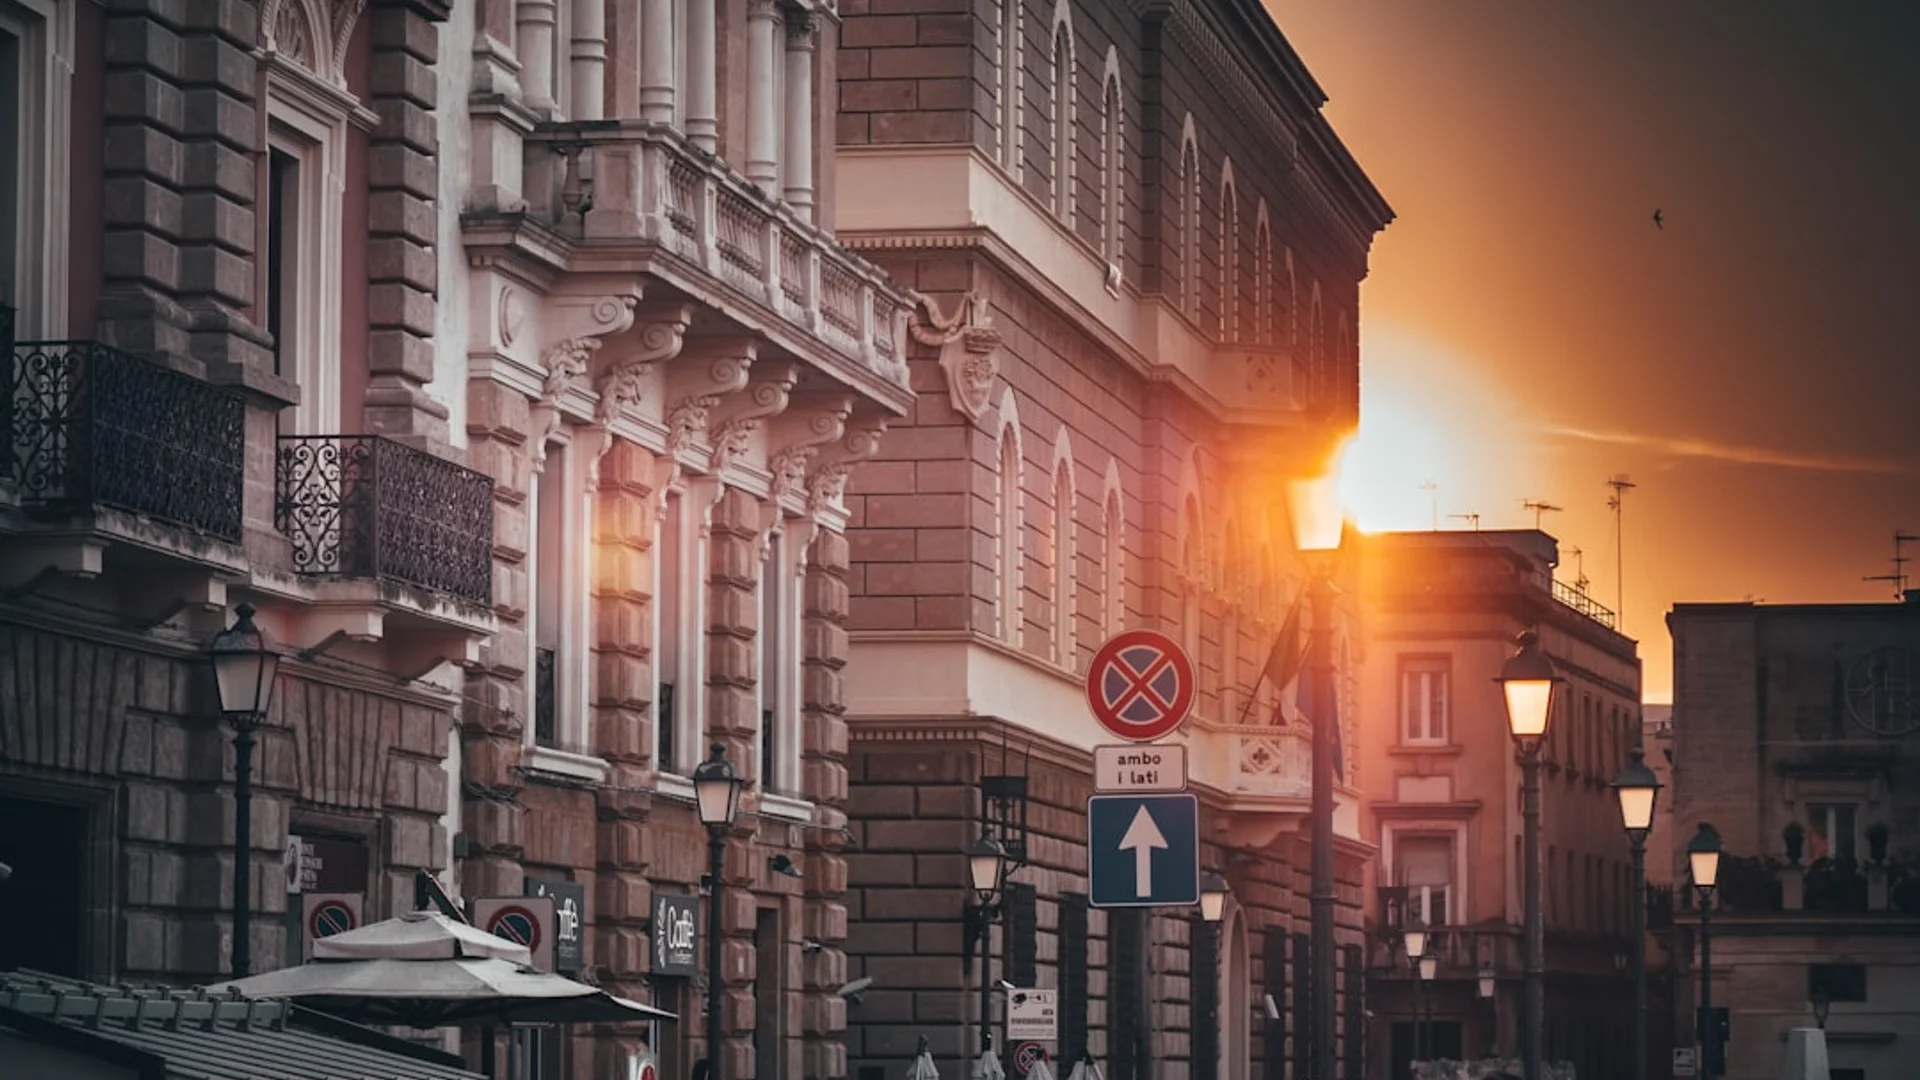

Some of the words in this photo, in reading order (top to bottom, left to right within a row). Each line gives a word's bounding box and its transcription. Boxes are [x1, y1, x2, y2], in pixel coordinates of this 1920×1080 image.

[1118, 752, 1161, 765] ambo
[1118, 771, 1122, 784] i
[1130, 770, 1158, 785] lati
[667, 905, 694, 949] Caffè
